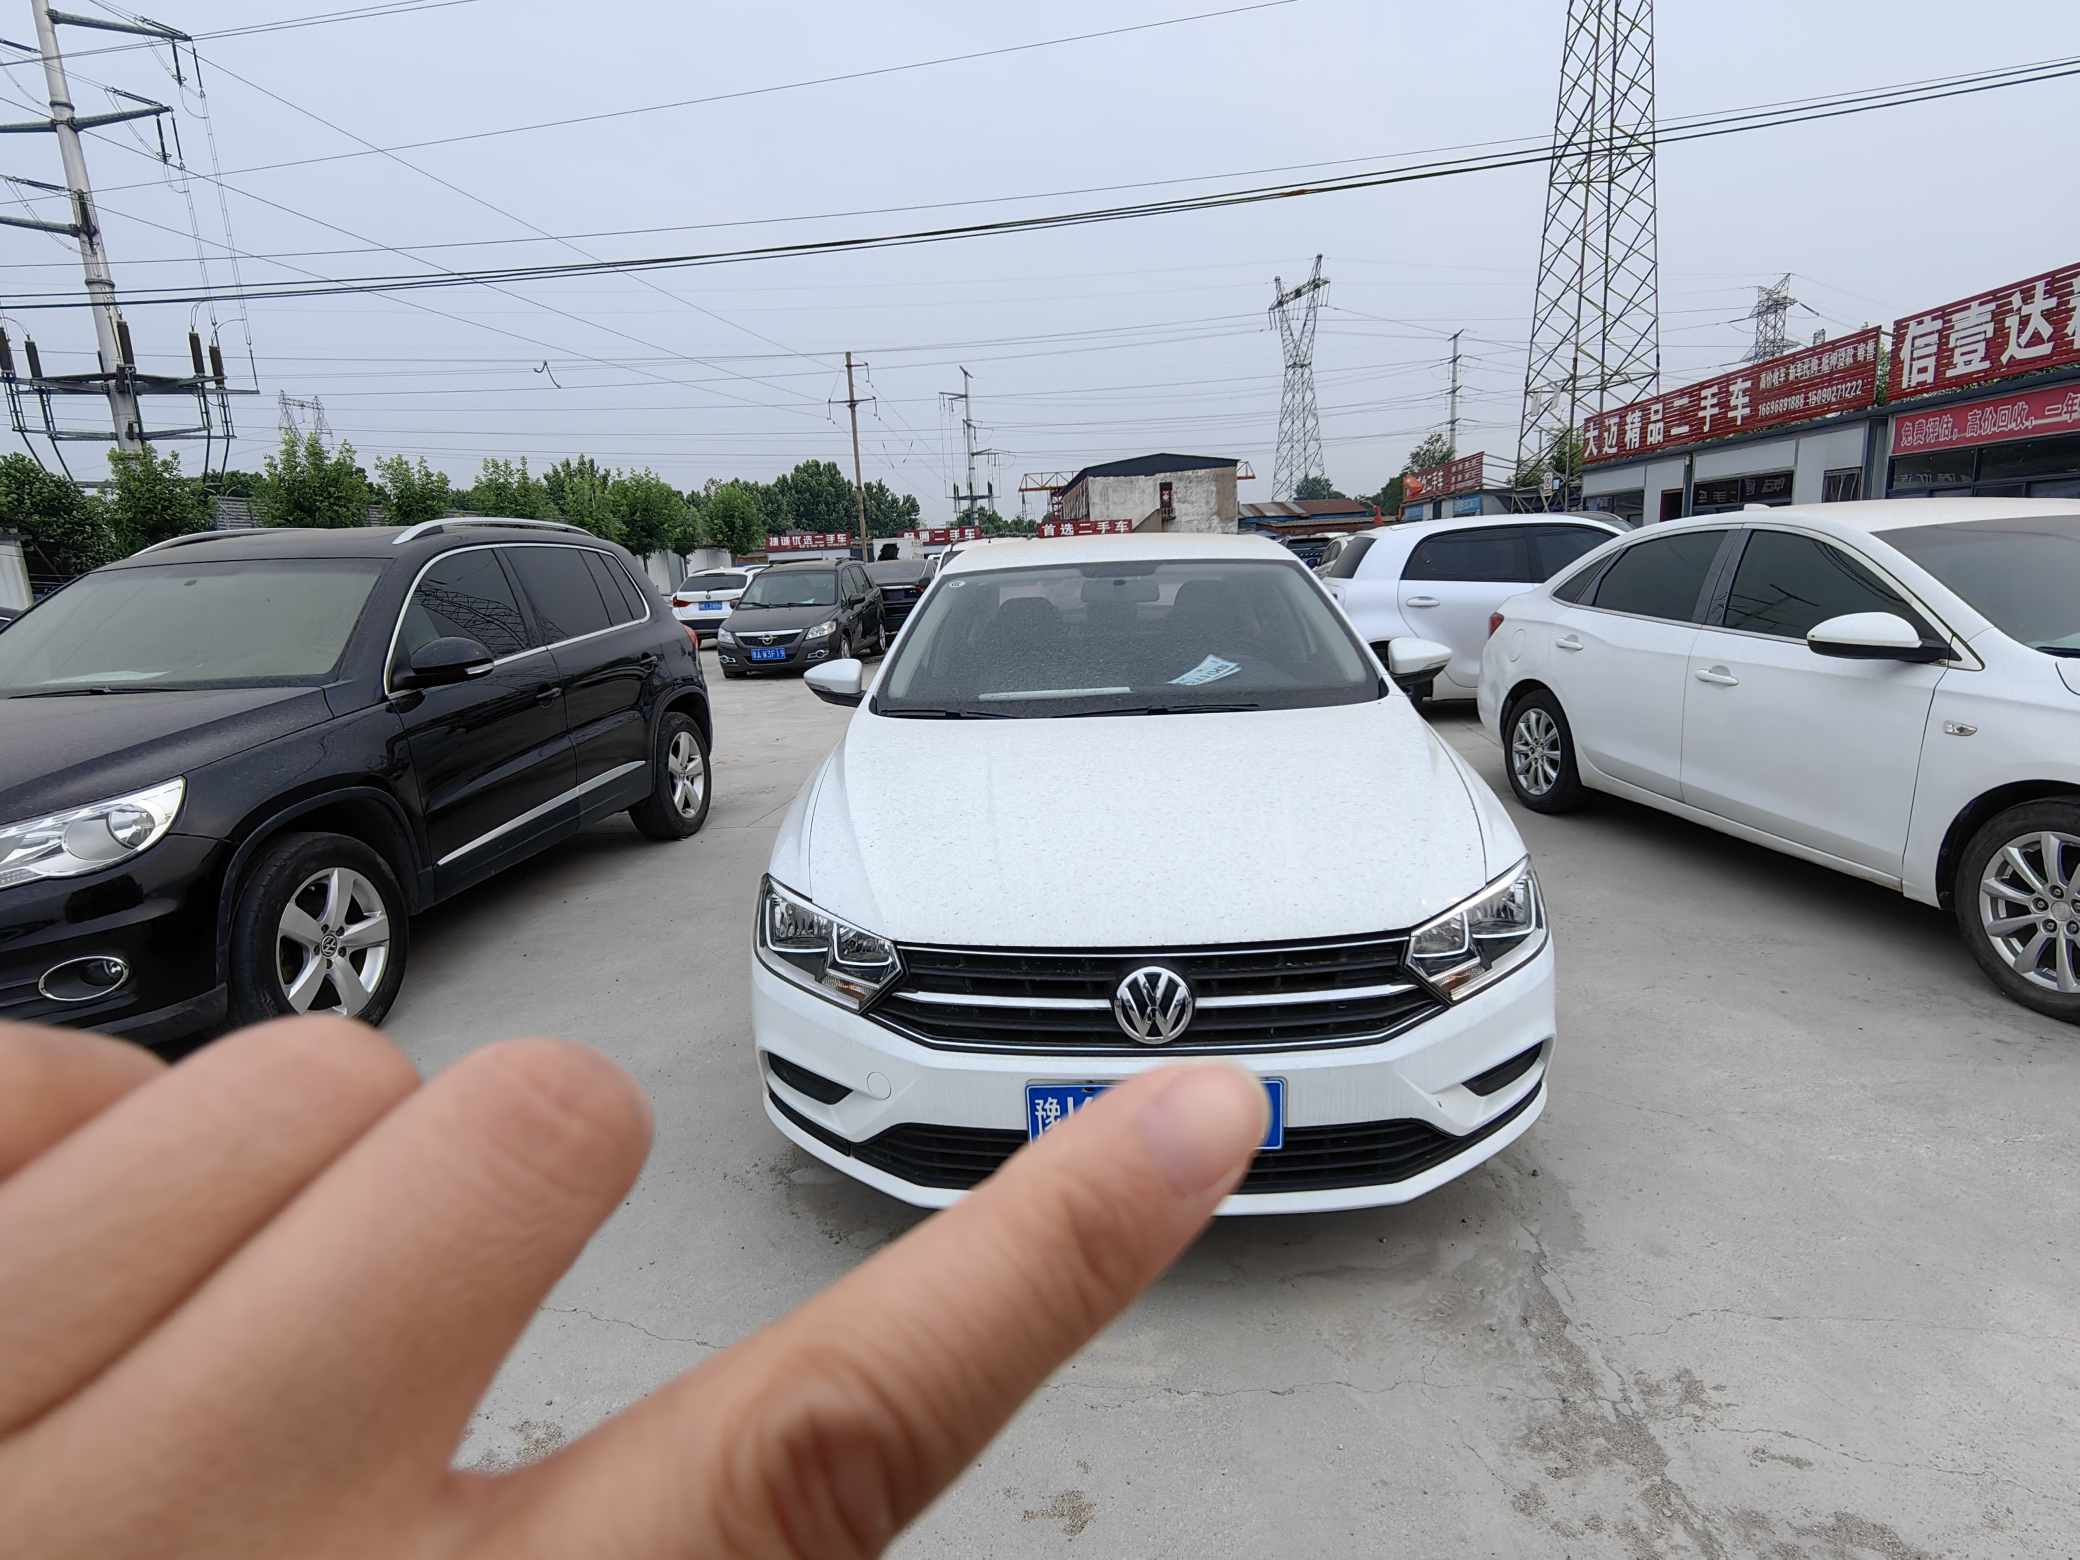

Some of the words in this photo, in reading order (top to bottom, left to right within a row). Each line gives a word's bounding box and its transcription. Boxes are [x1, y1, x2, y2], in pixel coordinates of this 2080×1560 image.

[1900, 275, 2080, 389] 信壹达
[1042, 520, 1130, 538] 首选二手车
